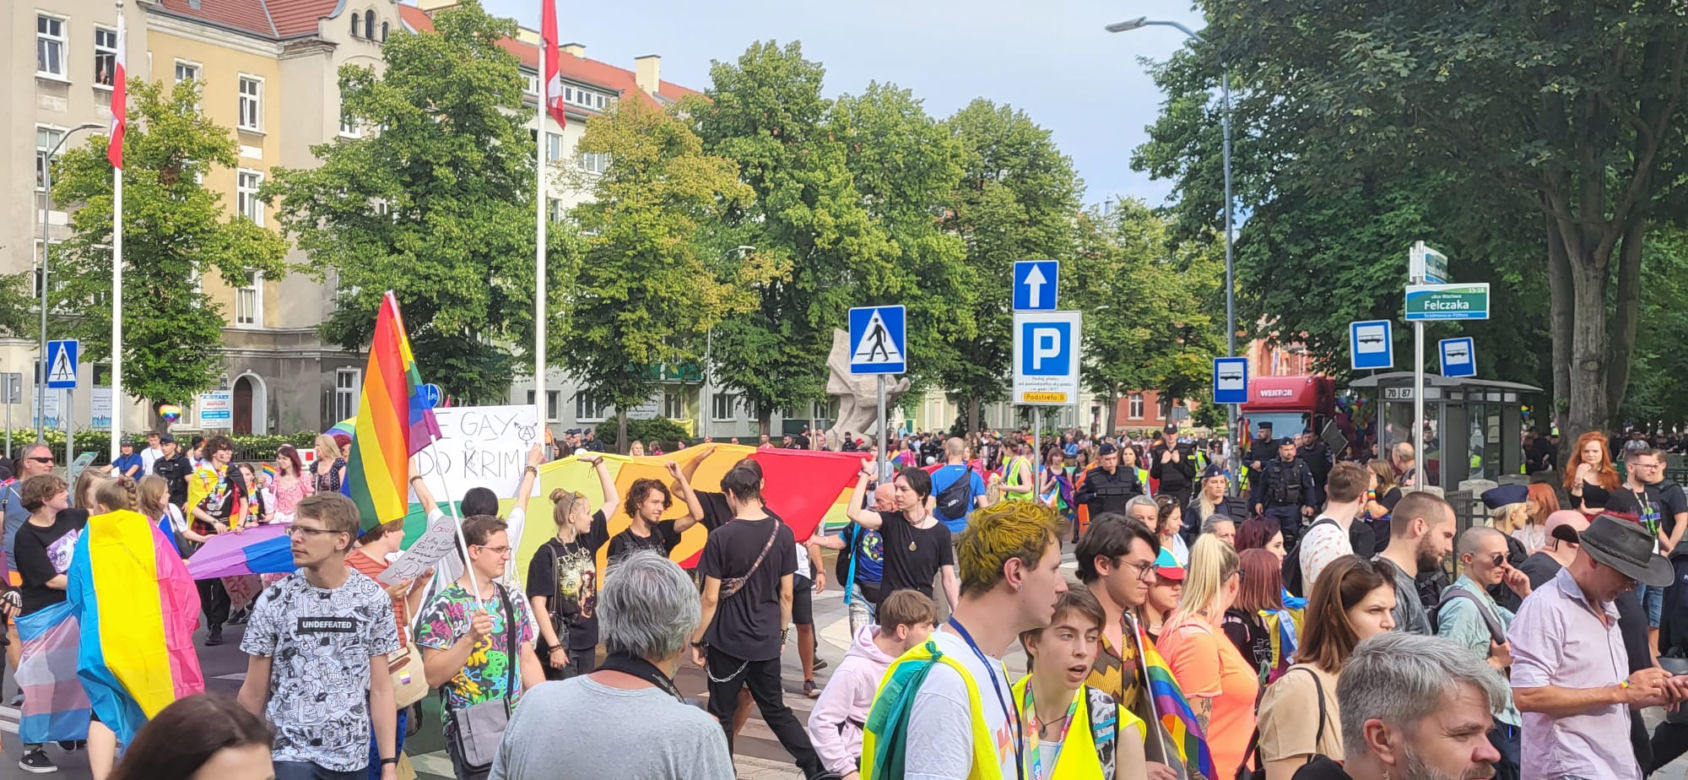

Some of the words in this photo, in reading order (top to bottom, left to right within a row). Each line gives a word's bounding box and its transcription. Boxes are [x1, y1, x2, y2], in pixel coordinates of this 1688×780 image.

[1424, 299, 1470, 310] Felczaka
[1033, 327, 1061, 370] P
[1387, 389, 1397, 397] 70
[1401, 389, 1411, 397] 87
[460, 410, 519, 442] GAY
[418, 449, 452, 477] DO
[462, 448, 528, 480] KRIM
[302, 620, 352, 629] UNDEFEATED
